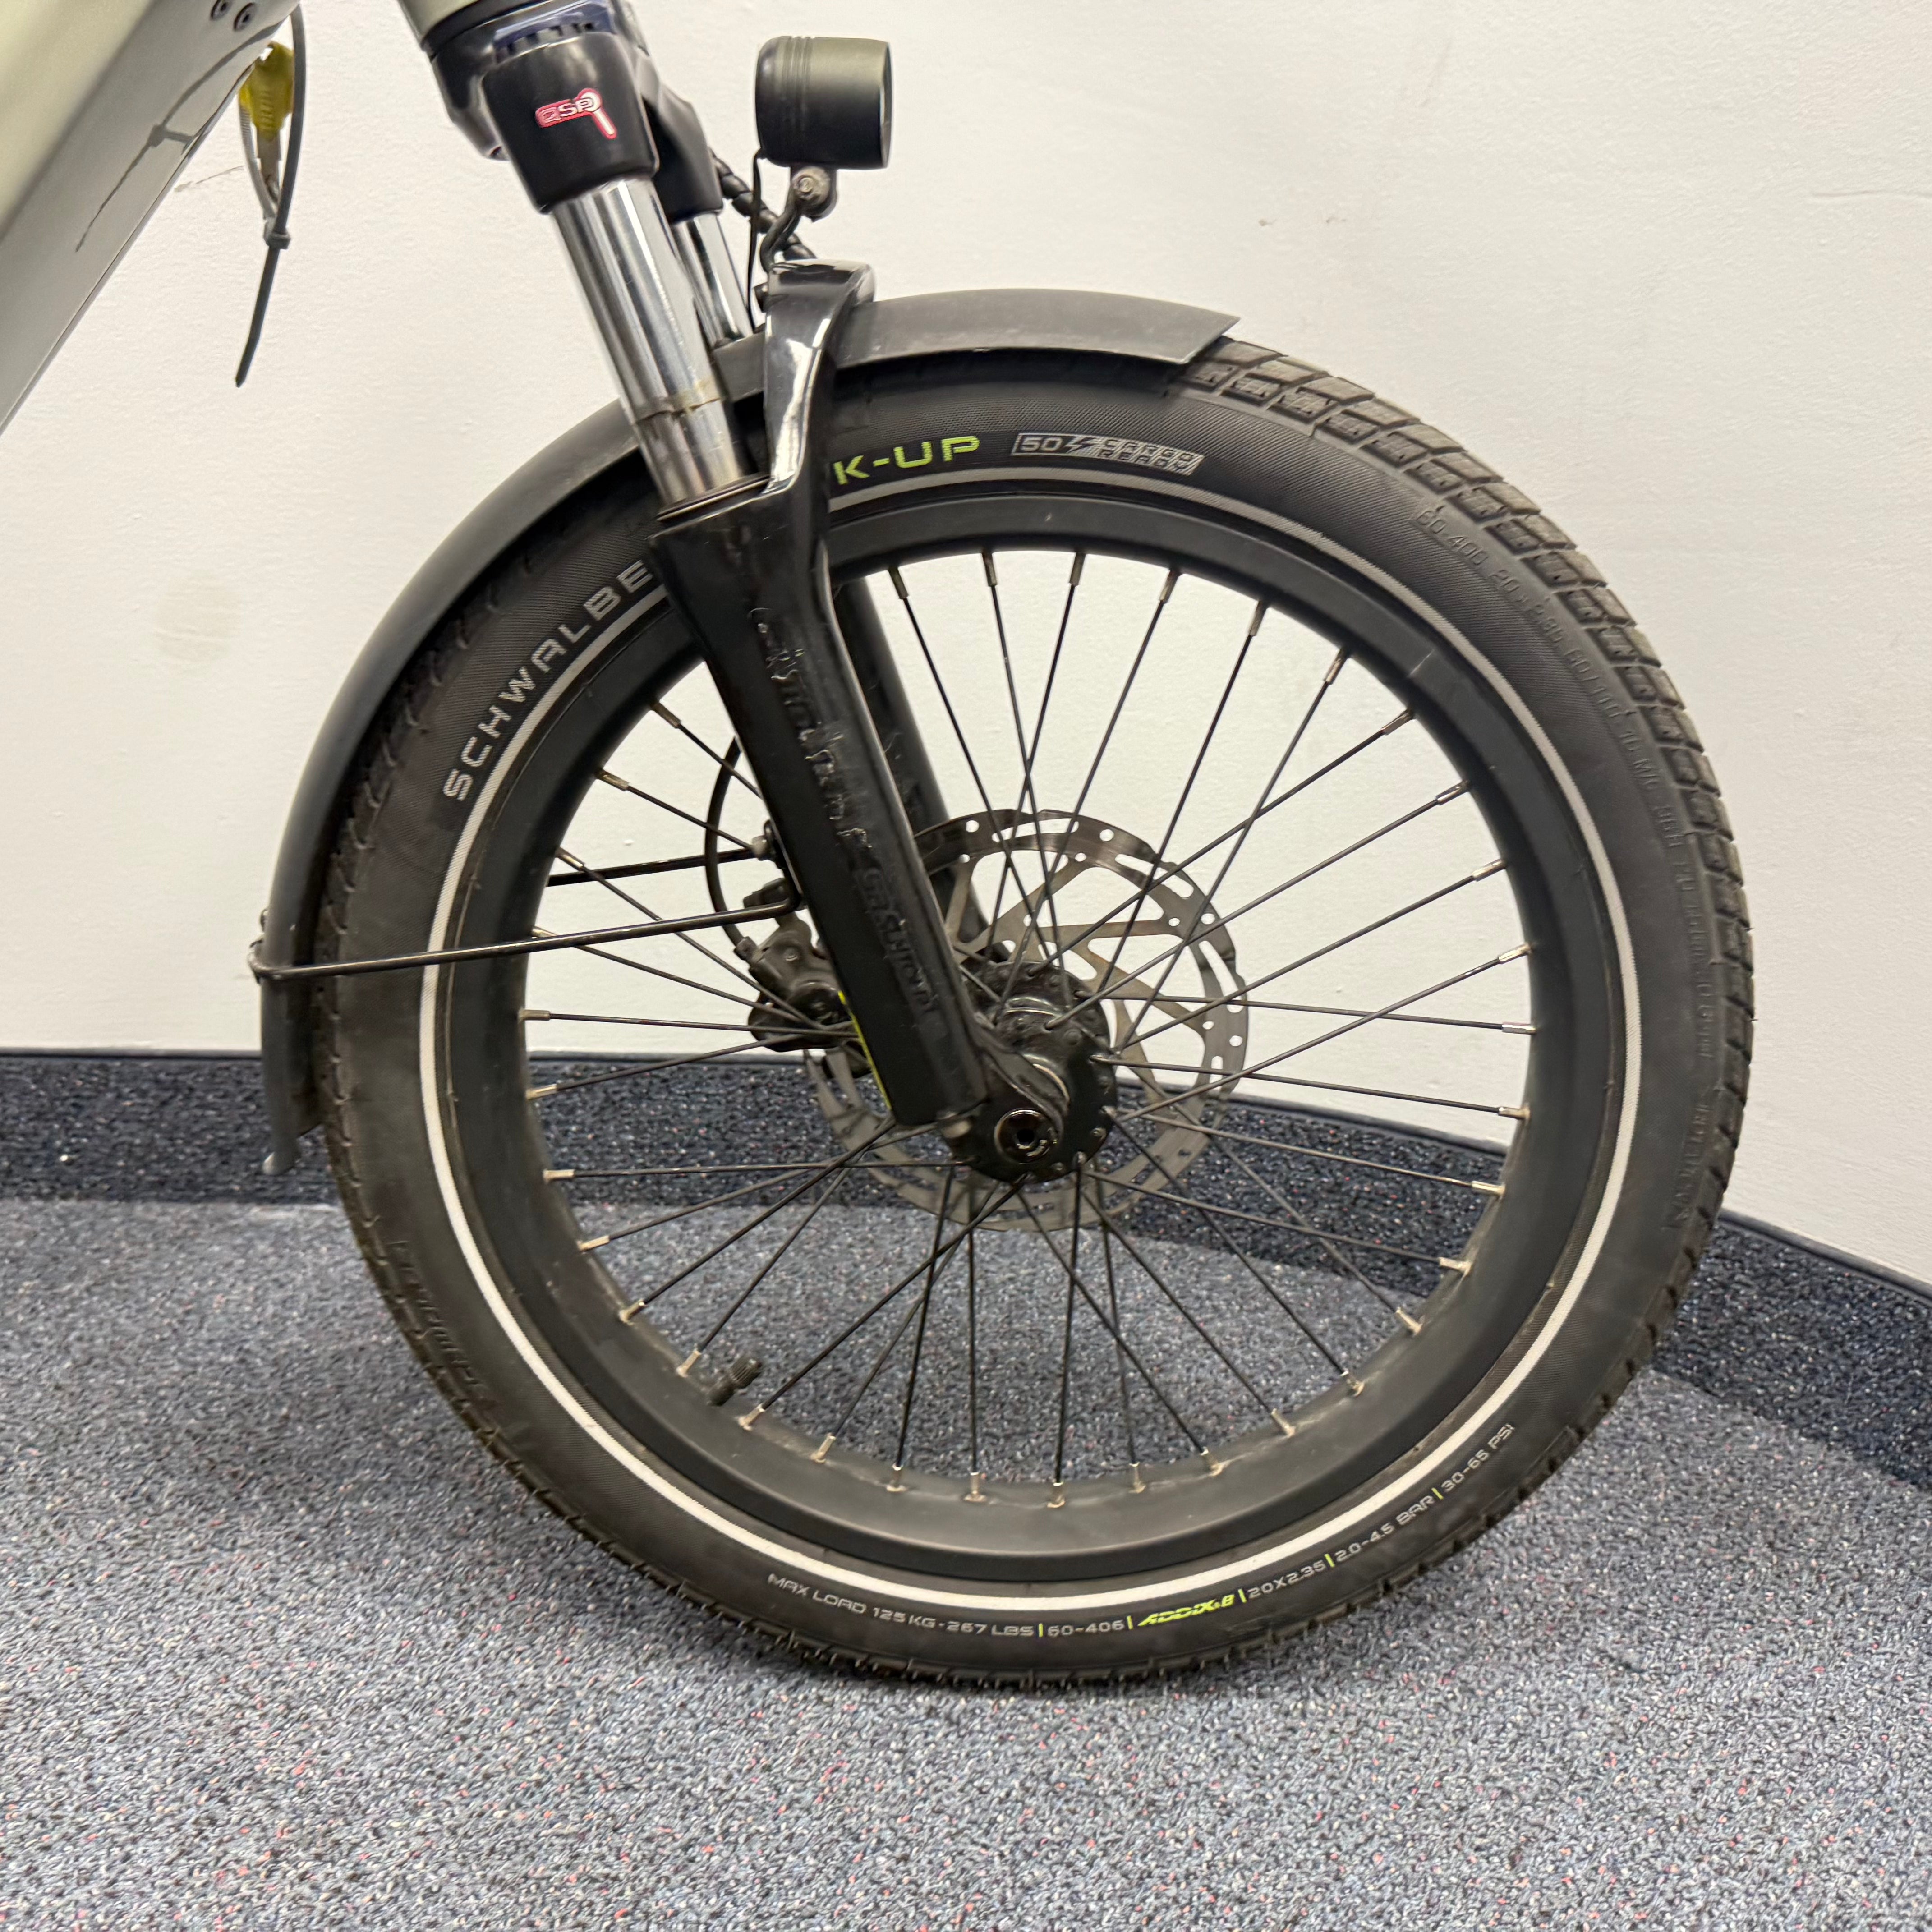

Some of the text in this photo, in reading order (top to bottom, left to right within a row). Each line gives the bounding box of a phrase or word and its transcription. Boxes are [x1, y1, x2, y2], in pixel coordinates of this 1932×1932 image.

[1021, 437, 1063, 452] 50
[443, 560, 653, 801] SCHWALBE
[768, 1573, 809, 1595] MAX
[813, 1589, 866, 1614] LOAD
[992, 1624, 1034, 1637] LBS
[1048, 1620, 1123, 1638] 60-406
[1396, 1495, 1437, 1527] BAR
[1441, 1449, 1490, 1493] 30-65
[1487, 1423, 1515, 1449] PSI
